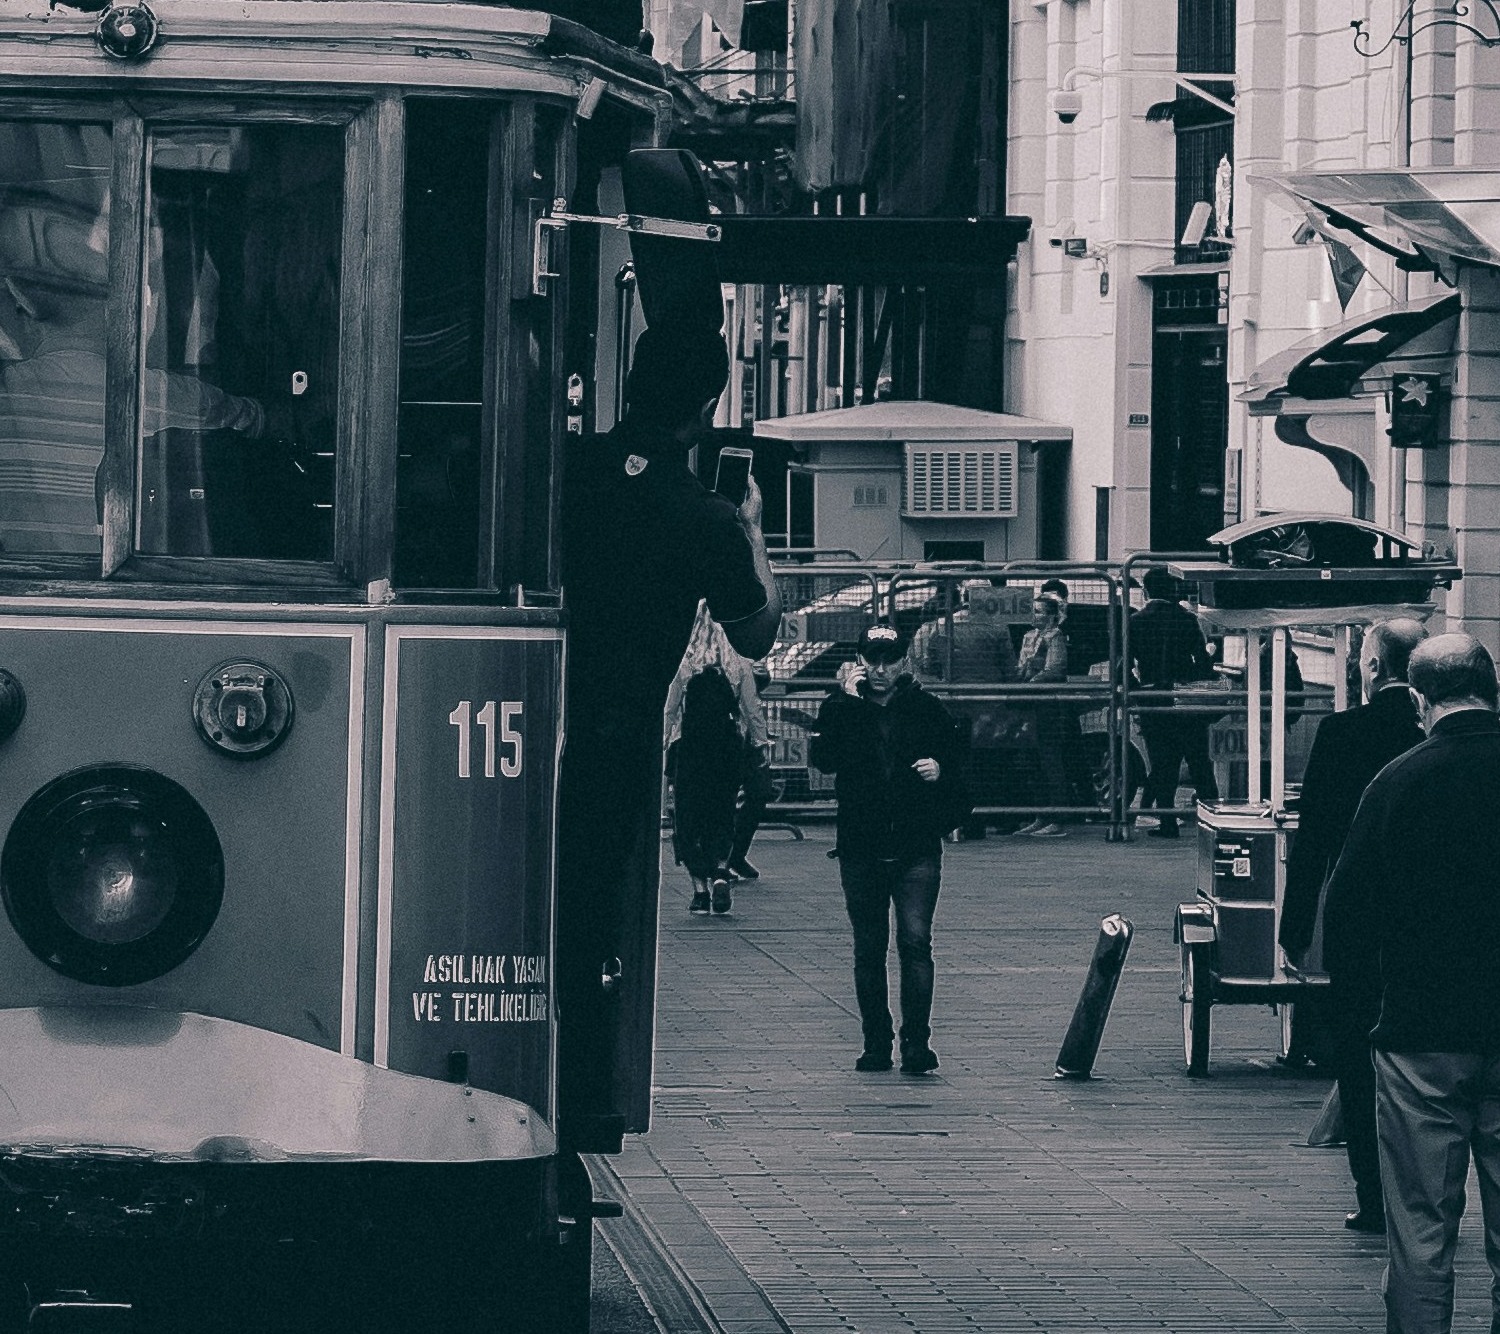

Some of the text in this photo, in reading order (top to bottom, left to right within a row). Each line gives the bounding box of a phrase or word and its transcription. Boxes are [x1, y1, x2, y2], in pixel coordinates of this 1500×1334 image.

[449, 700, 523, 778] 115
[423, 954, 546, 984] ASILMAK YASAK
[412, 992, 442, 1022] VE
